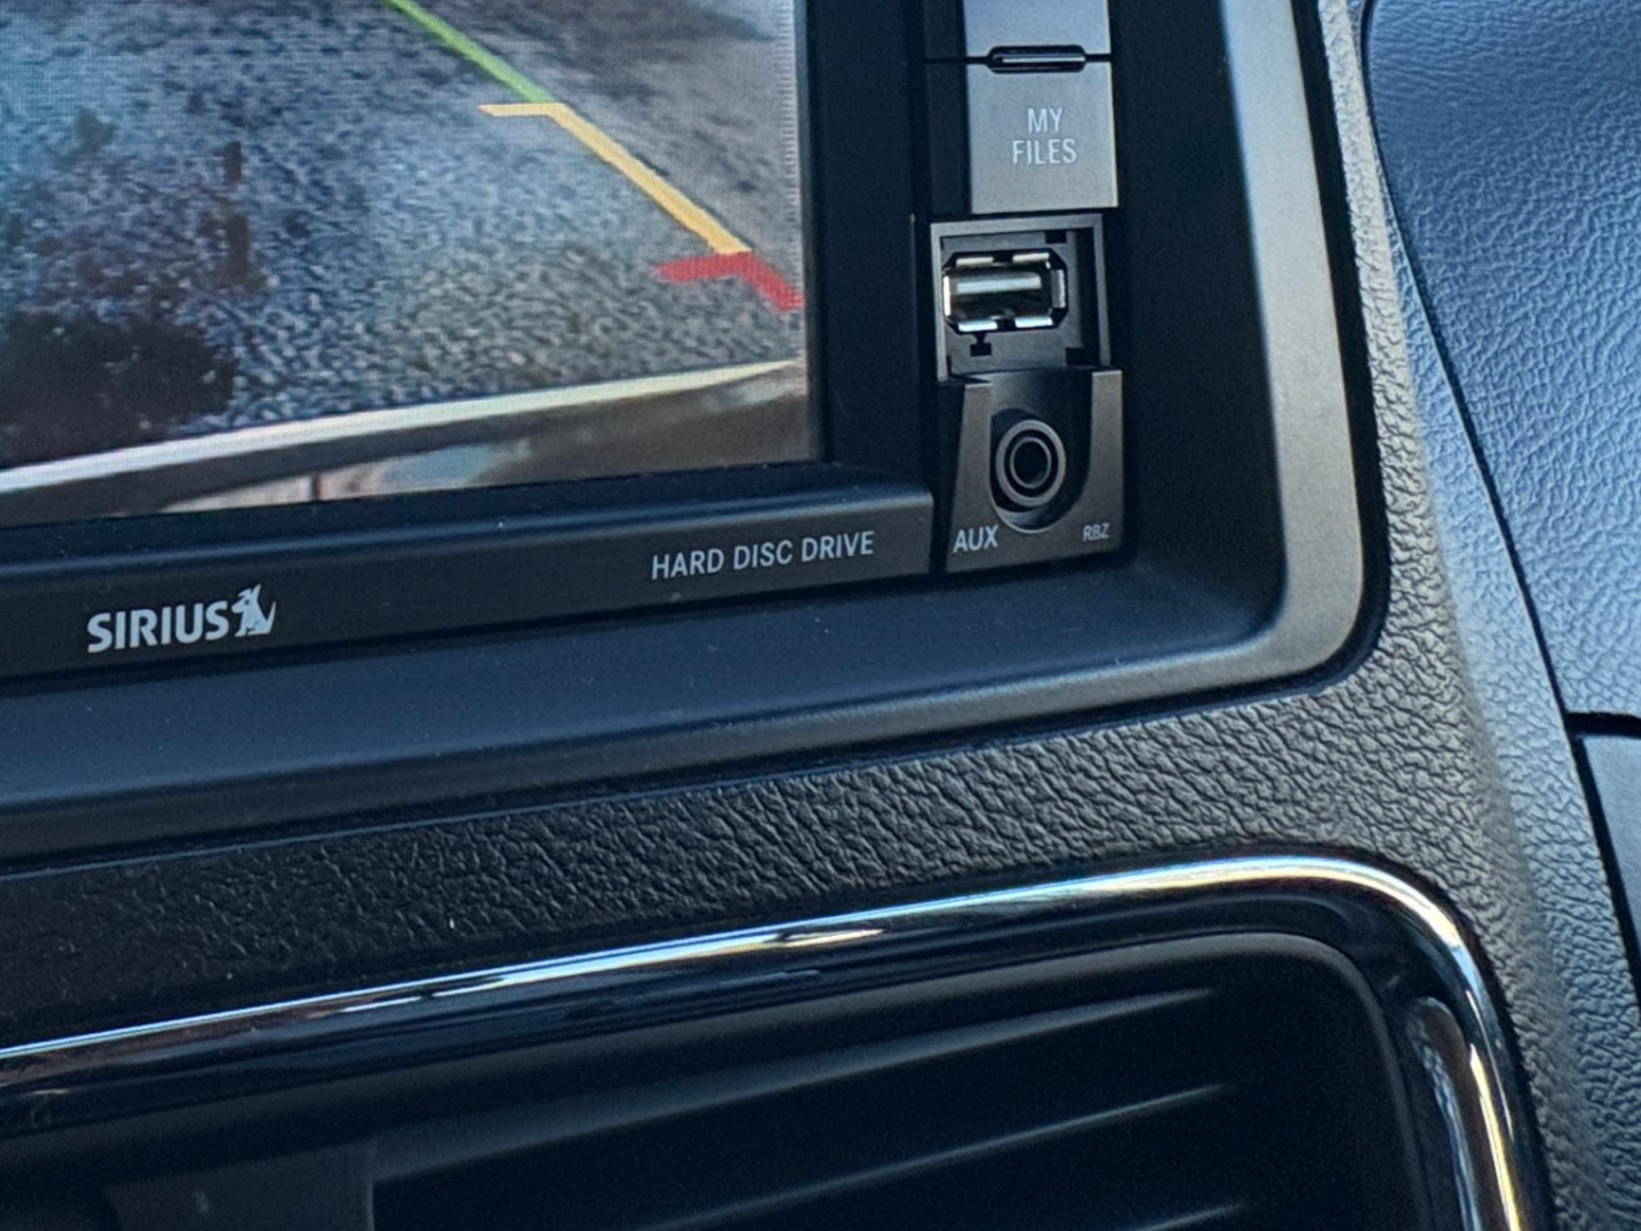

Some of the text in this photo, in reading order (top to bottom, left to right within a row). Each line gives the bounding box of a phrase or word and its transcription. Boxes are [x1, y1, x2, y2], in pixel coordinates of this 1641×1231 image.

[1027, 107, 1063, 134] MY
[1012, 138, 1078, 165] FILES
[952, 524, 1000, 555] AUX
[1082, 522, 1111, 543] RBZ
[651, 530, 876, 581] HARD DISC DRIVE
[86, 599, 229, 654] SIRIUS
